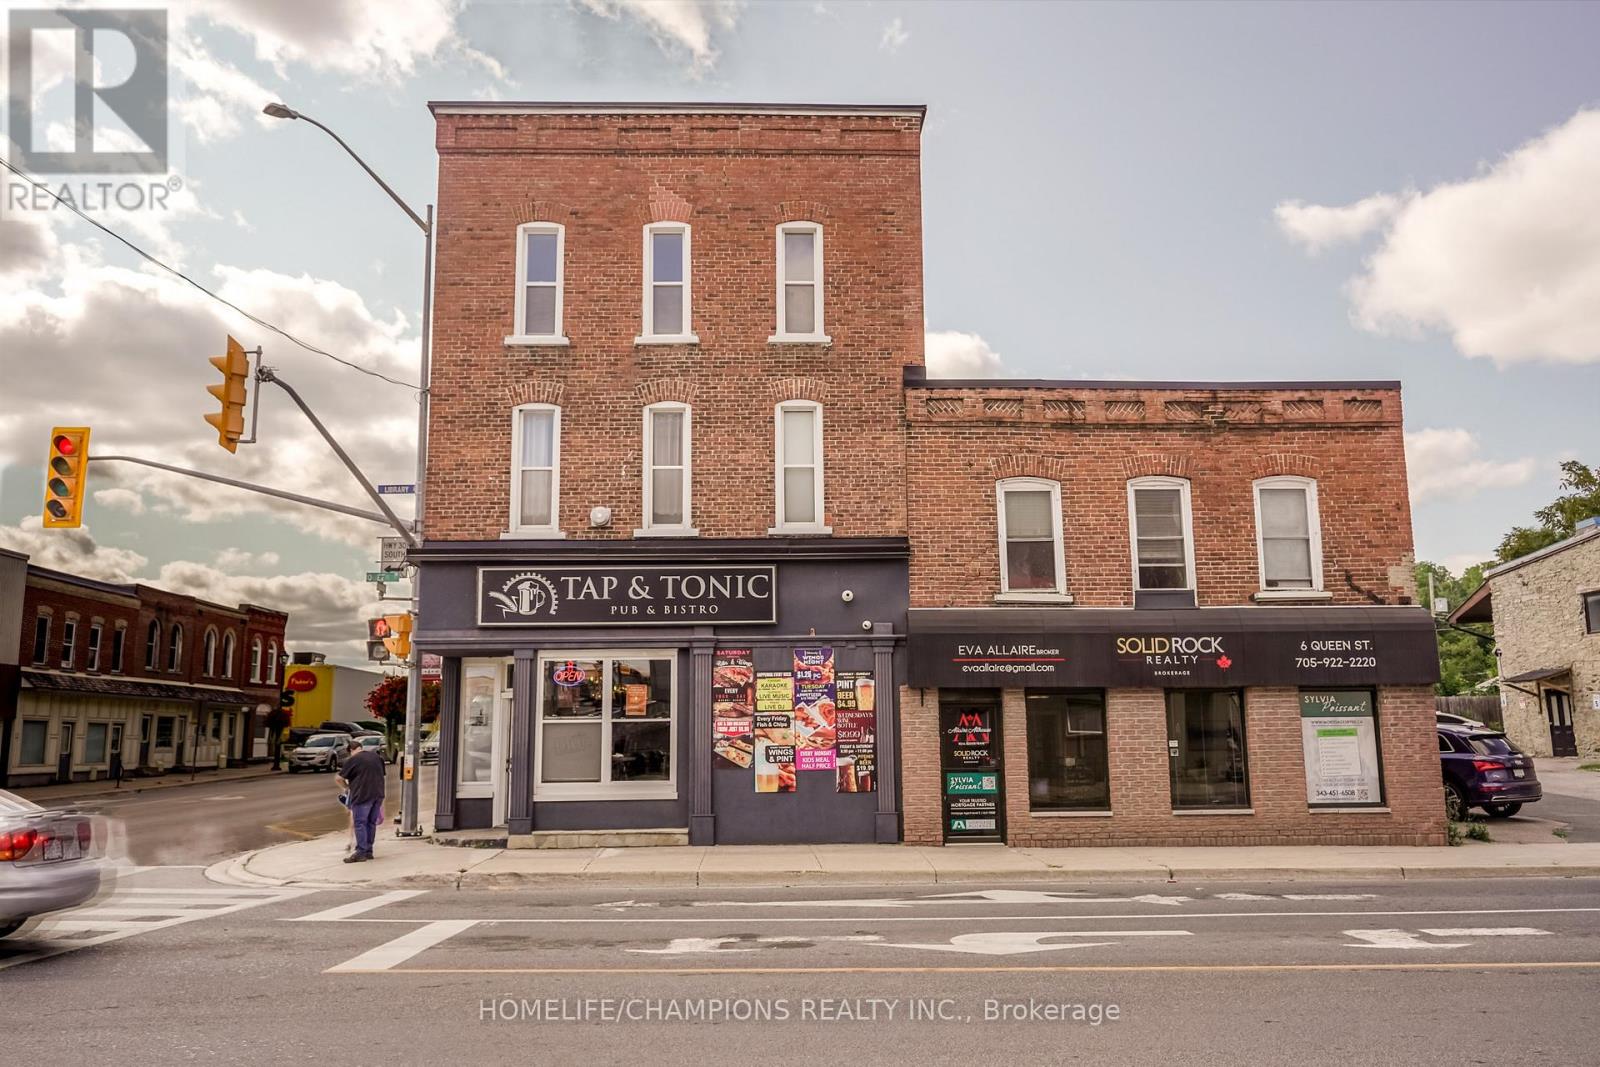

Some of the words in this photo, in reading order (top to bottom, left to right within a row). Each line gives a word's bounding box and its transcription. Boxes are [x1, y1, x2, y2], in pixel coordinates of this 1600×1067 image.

[384, 551, 406, 559] SOUTH
[560, 576, 619, 600] TAP
[628, 575, 654, 600] &
[660, 575, 769, 600] TONIC
[611, 604, 638, 615] PUB
[647, 604, 656, 615] &
[664, 603, 719, 615] BISTRO
[958, 645, 983, 655] EVA
[986, 645, 1036, 655] ALLAIRE
[1300, 640, 1308, 651] 6
[1310, 640, 1351, 651] QUEEN
[1354, 640, 1373, 650] ST.
[1146, 655, 1199, 665] REALTY
[1295, 657, 1377, 668] 705-922-2220
[962, 662, 1055, 673] evaallaire@gmail.com
[555, 671, 583, 682] OPEN
[836, 680, 854, 689] PINT
[837, 692, 854, 700] BEER
[1304, 696, 1336, 704] SYLVIA
[1322, 701, 1367, 712] Poissant
